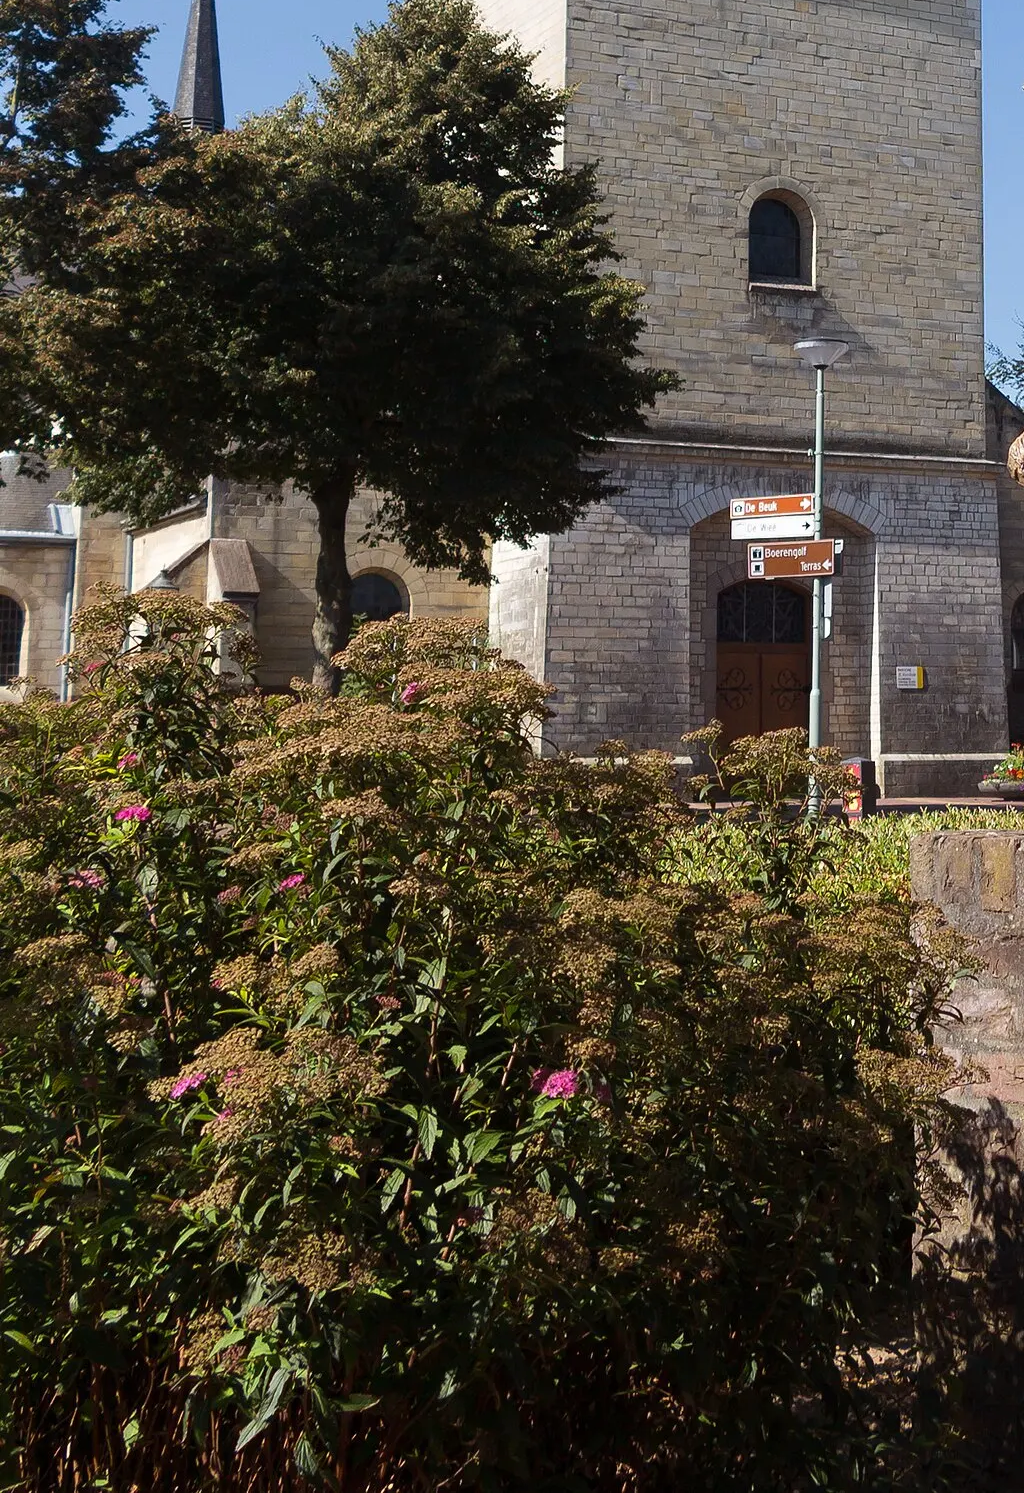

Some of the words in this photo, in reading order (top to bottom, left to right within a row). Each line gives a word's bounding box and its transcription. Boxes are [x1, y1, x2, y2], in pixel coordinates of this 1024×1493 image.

[746, 503, 756, 514] De
[758, 501, 778, 512] Beuk
[765, 546, 807, 559] Boerengolf
[800, 561, 822, 572] Terras
